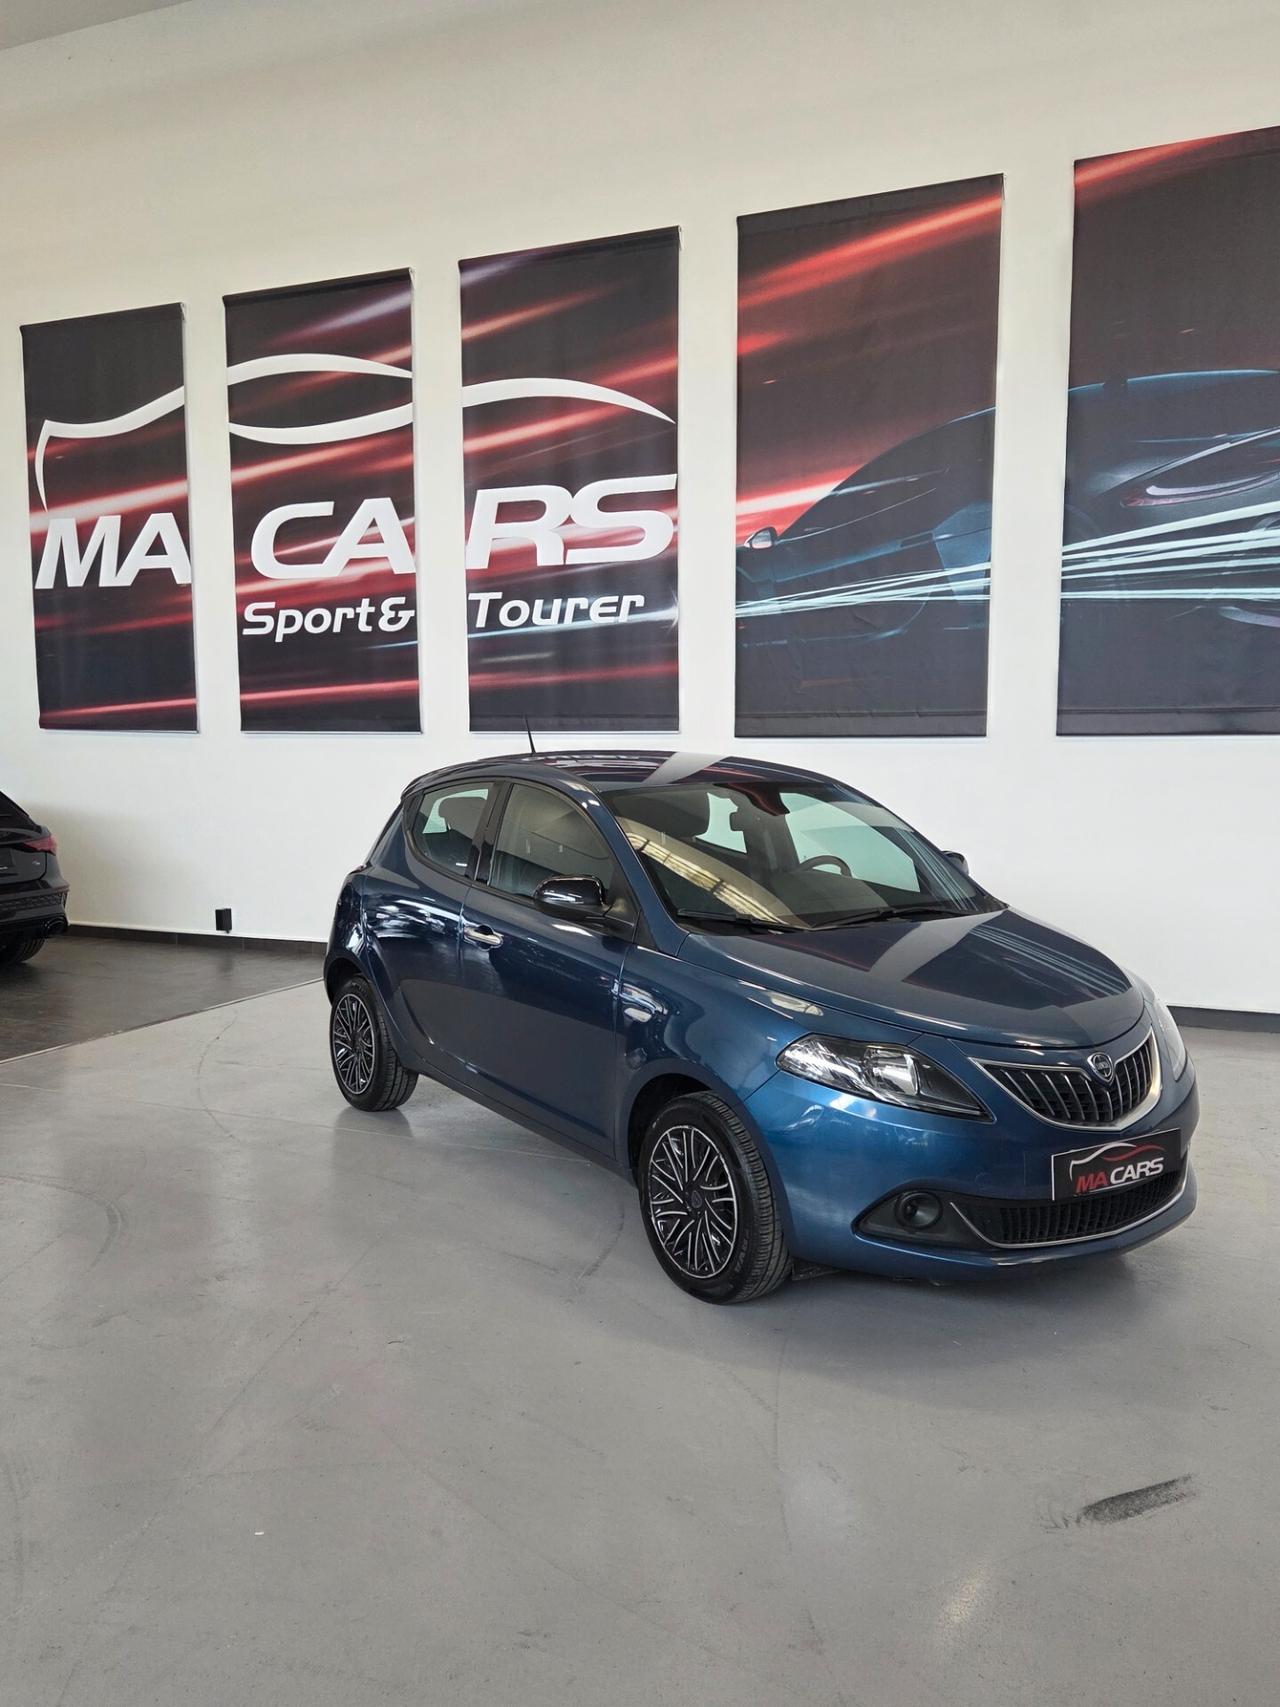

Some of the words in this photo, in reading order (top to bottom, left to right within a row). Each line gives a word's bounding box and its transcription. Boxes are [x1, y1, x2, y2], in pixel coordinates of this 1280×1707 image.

[34, 512, 192, 590] MA
[468, 592, 645, 628] Tourer
[1076, 1171, 1108, 1194] MA
[1109, 1157, 1165, 1184] CARS
